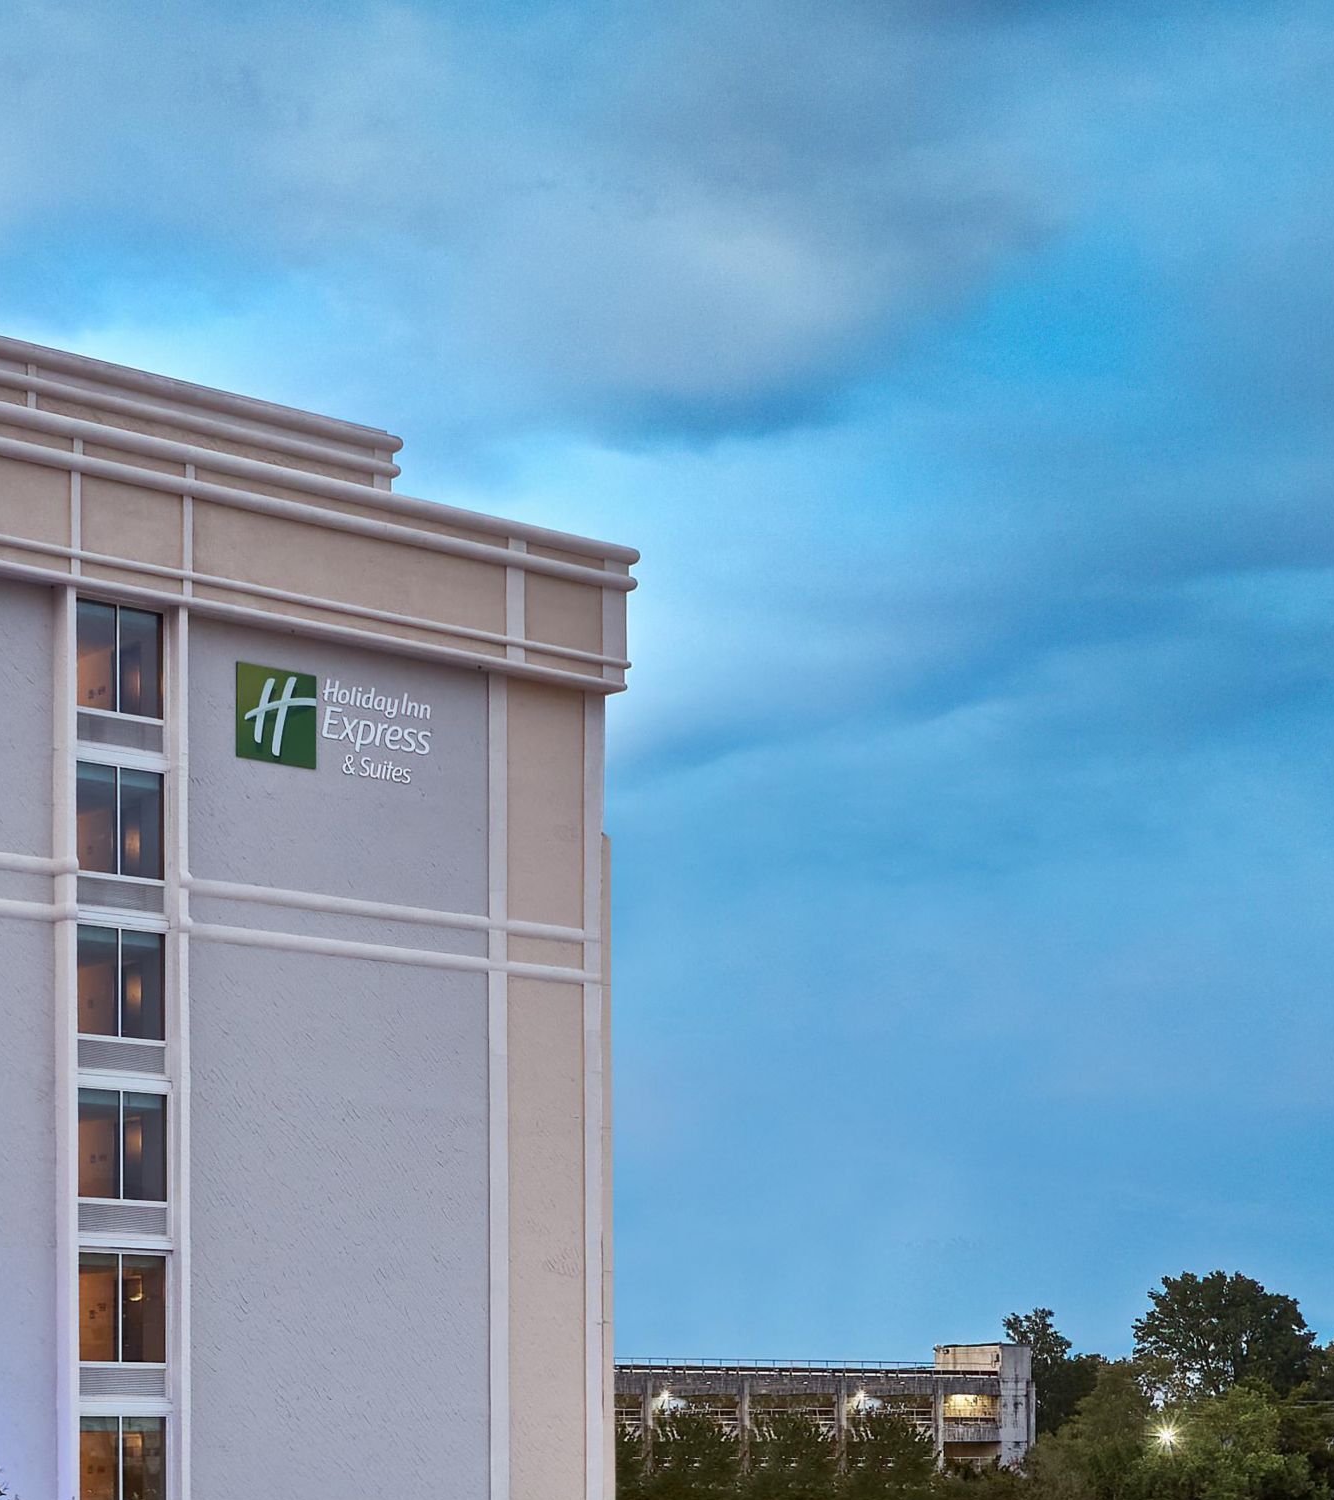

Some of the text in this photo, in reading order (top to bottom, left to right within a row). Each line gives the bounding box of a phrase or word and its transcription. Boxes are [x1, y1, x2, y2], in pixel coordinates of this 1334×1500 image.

[322, 678, 431, 720] Holiday Inn
[322, 706, 432, 755] Express
[342, 754, 412, 784] & Suites
